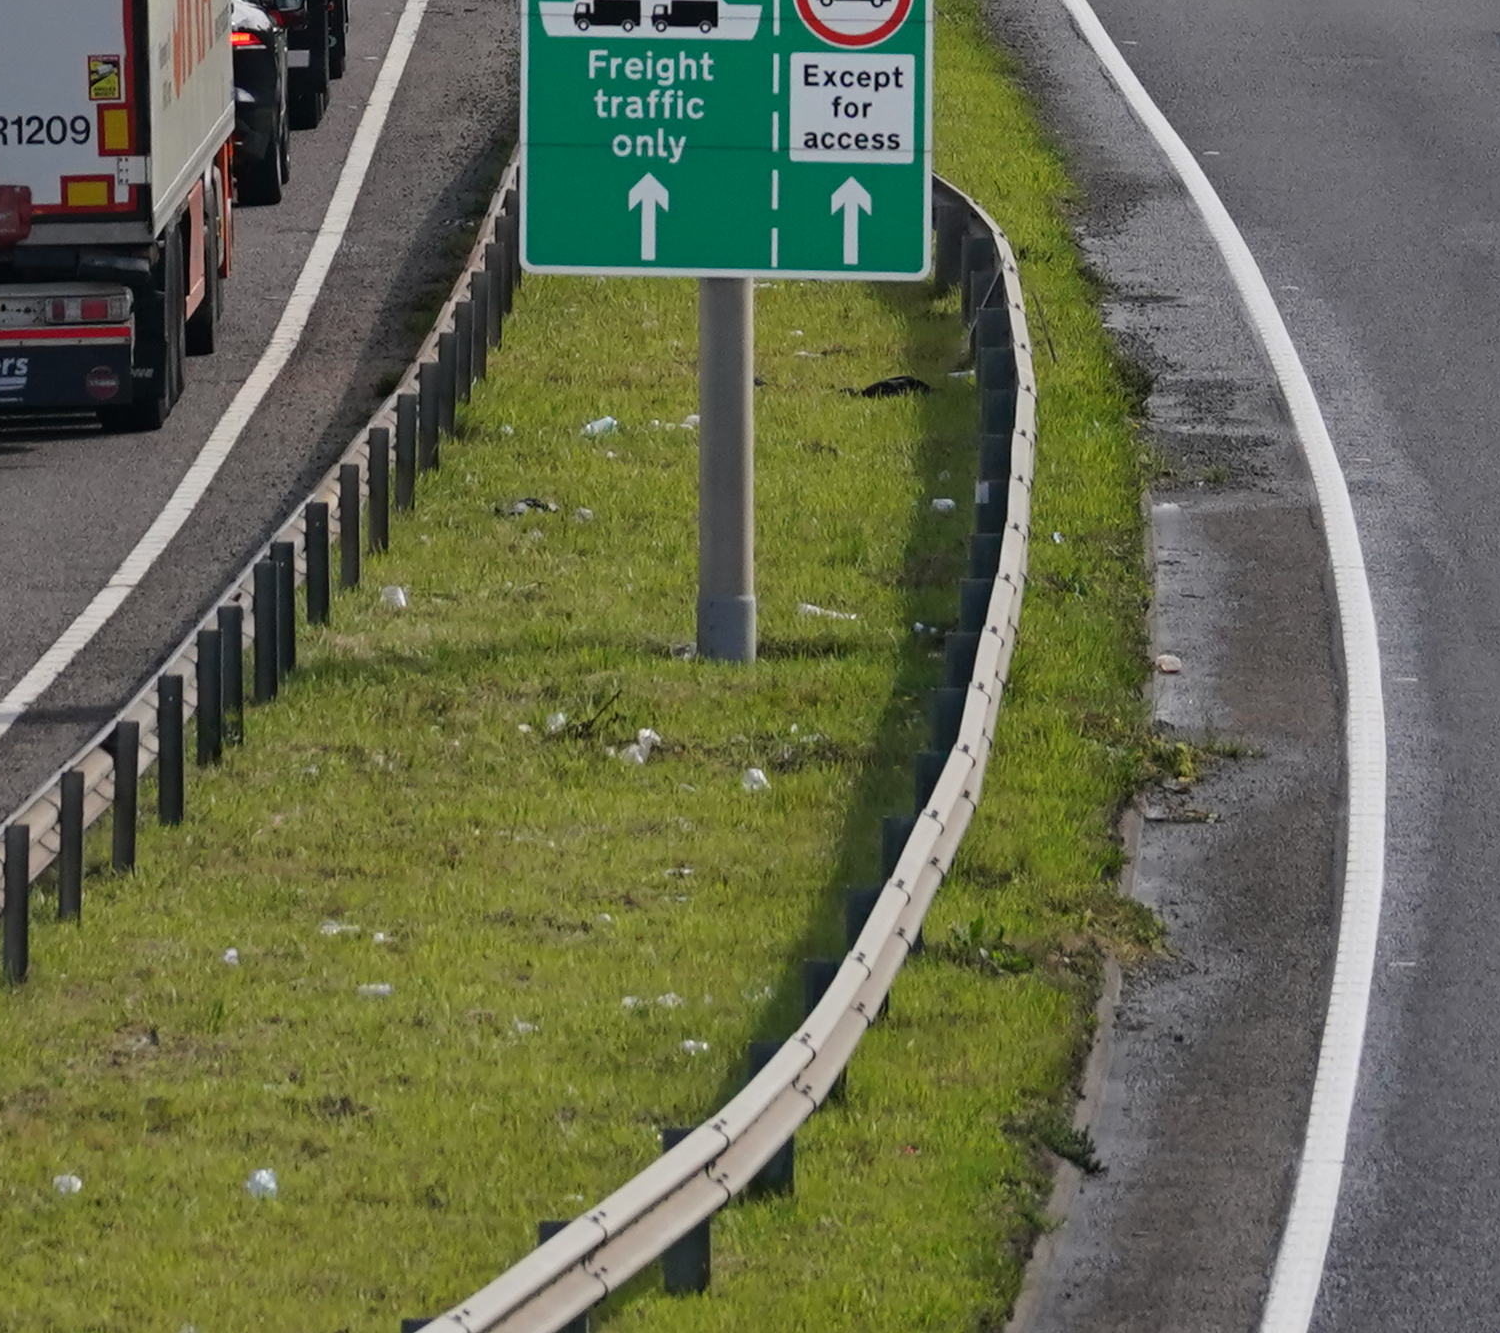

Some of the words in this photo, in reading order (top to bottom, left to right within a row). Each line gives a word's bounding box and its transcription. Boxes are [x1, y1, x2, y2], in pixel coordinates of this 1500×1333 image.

[588, 49, 715, 86] Freight
[803, 64, 903, 92] Except
[594, 89, 704, 120] traffic
[832, 95, 873, 119] for
[612, 128, 687, 164] only
[804, 129, 900, 151] access
